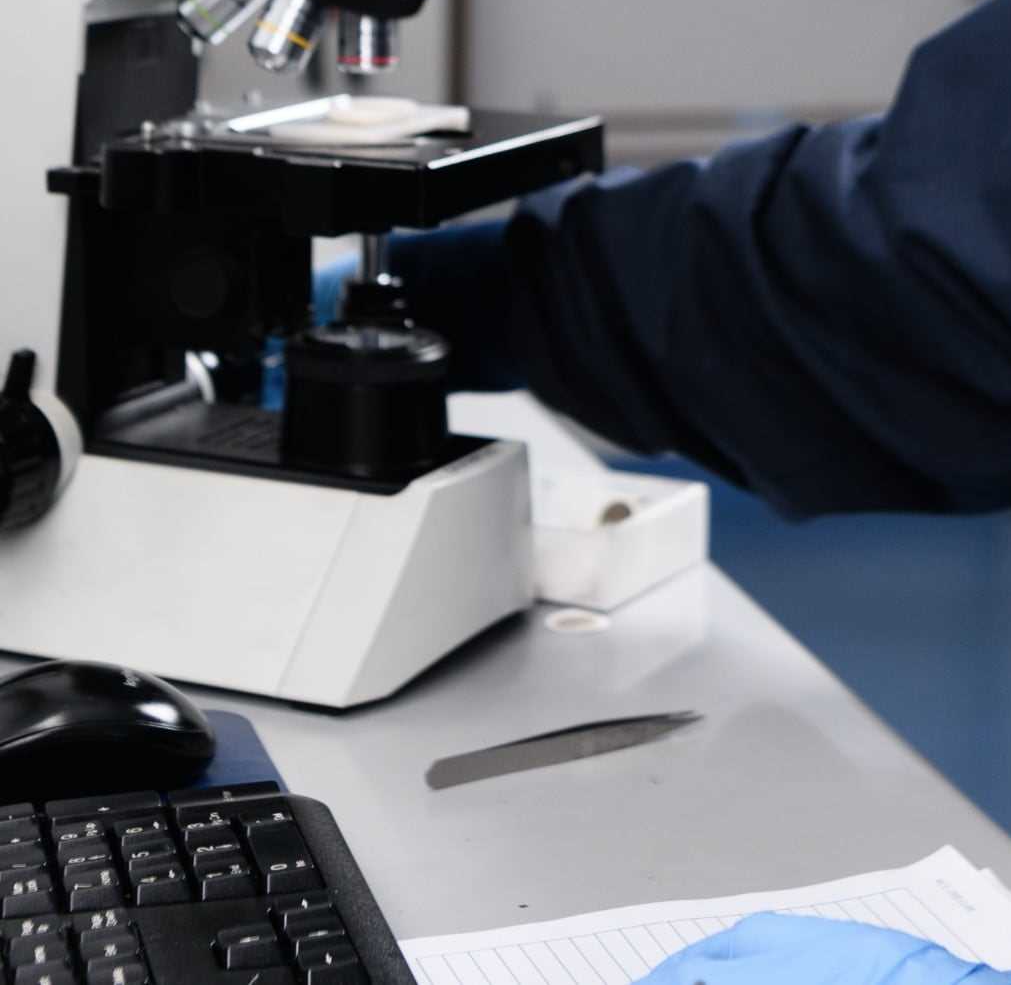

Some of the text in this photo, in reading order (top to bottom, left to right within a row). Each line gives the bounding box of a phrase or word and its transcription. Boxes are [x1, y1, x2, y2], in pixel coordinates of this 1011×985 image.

[187, 822, 205, 830] 3
[125, 827, 143, 835] 6
[60, 833, 78, 841] 9
[131, 851, 149, 859] 5
